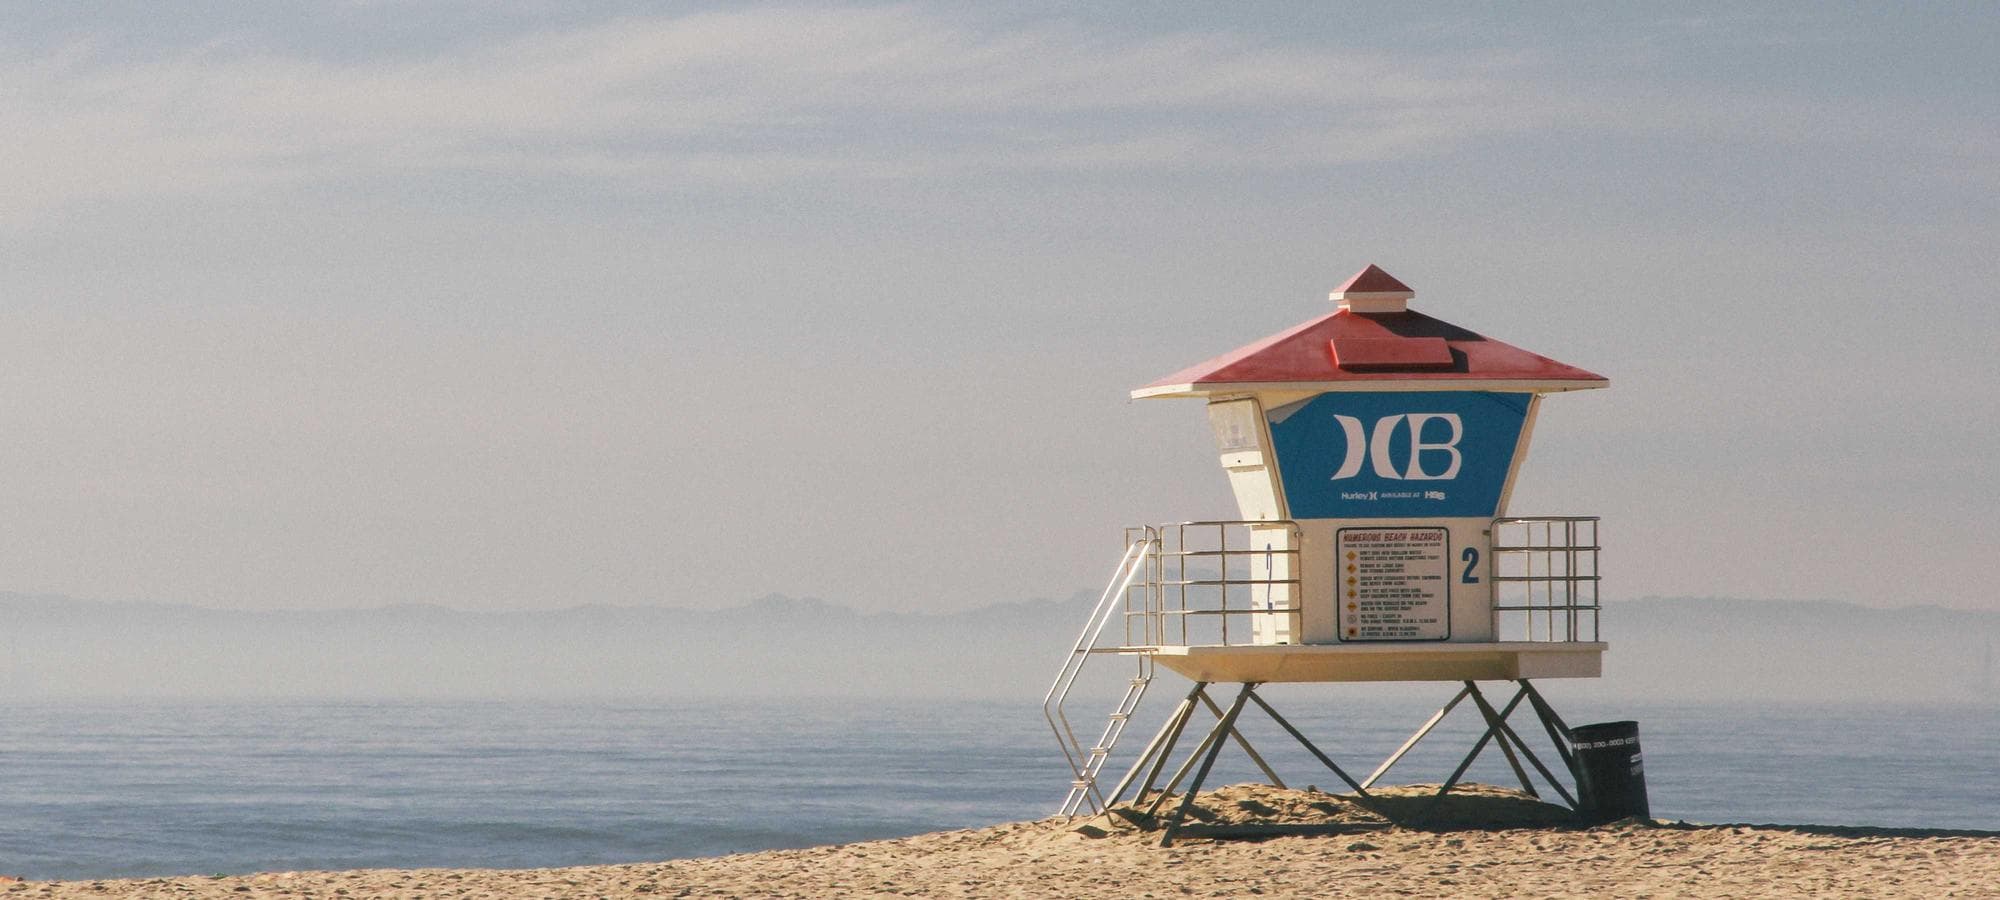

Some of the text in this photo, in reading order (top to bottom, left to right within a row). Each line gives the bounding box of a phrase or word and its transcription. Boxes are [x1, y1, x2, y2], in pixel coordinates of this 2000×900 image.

[1341, 491, 1369, 500] Hurley
[1344, 532, 1443, 542] NUMEROUS BEACH HAZARDS
[1462, 547, 1480, 584] 2
